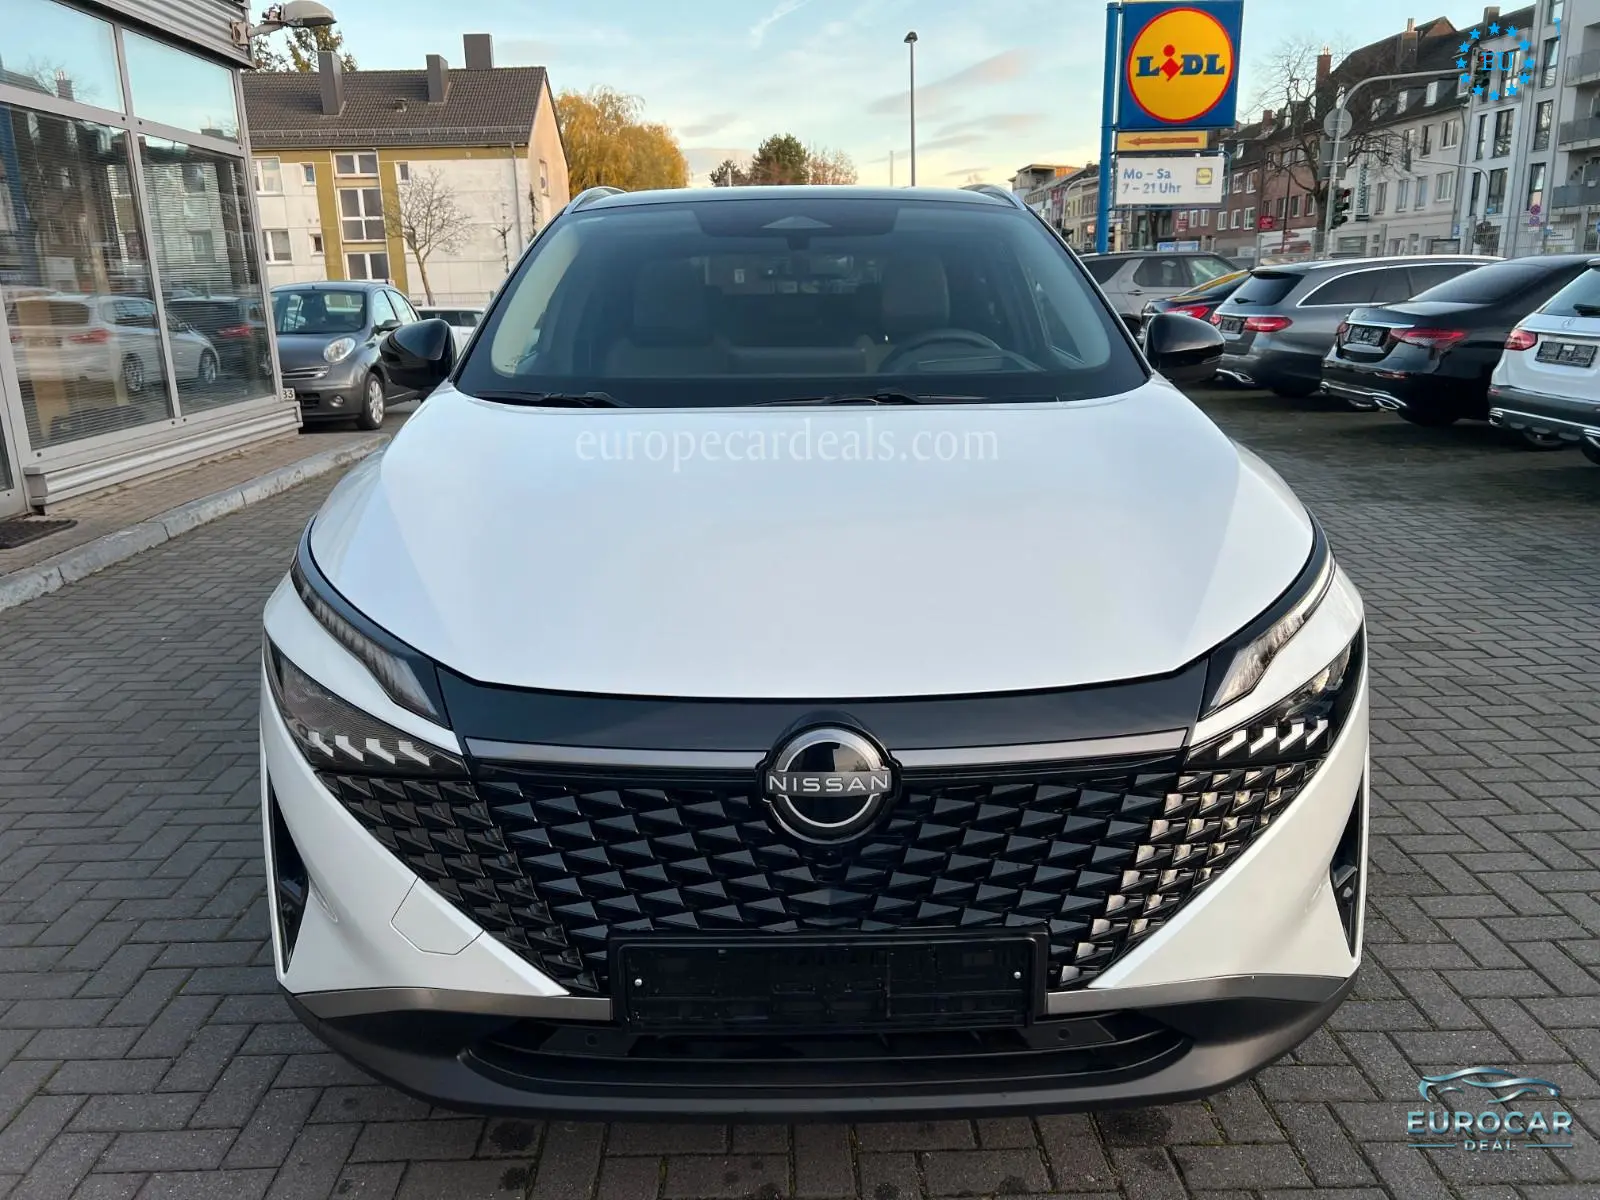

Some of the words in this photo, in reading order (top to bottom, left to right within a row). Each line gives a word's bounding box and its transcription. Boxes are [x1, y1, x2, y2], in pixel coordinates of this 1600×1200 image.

[1123, 168, 1143, 180] Mo
[1156, 168, 1171, 180] Sa
[1122, 183, 1130, 194] 7
[1143, 182, 1156, 194] 21
[1160, 181, 1182, 193] Uhr
[768, 774, 888, 792] NISSAN
